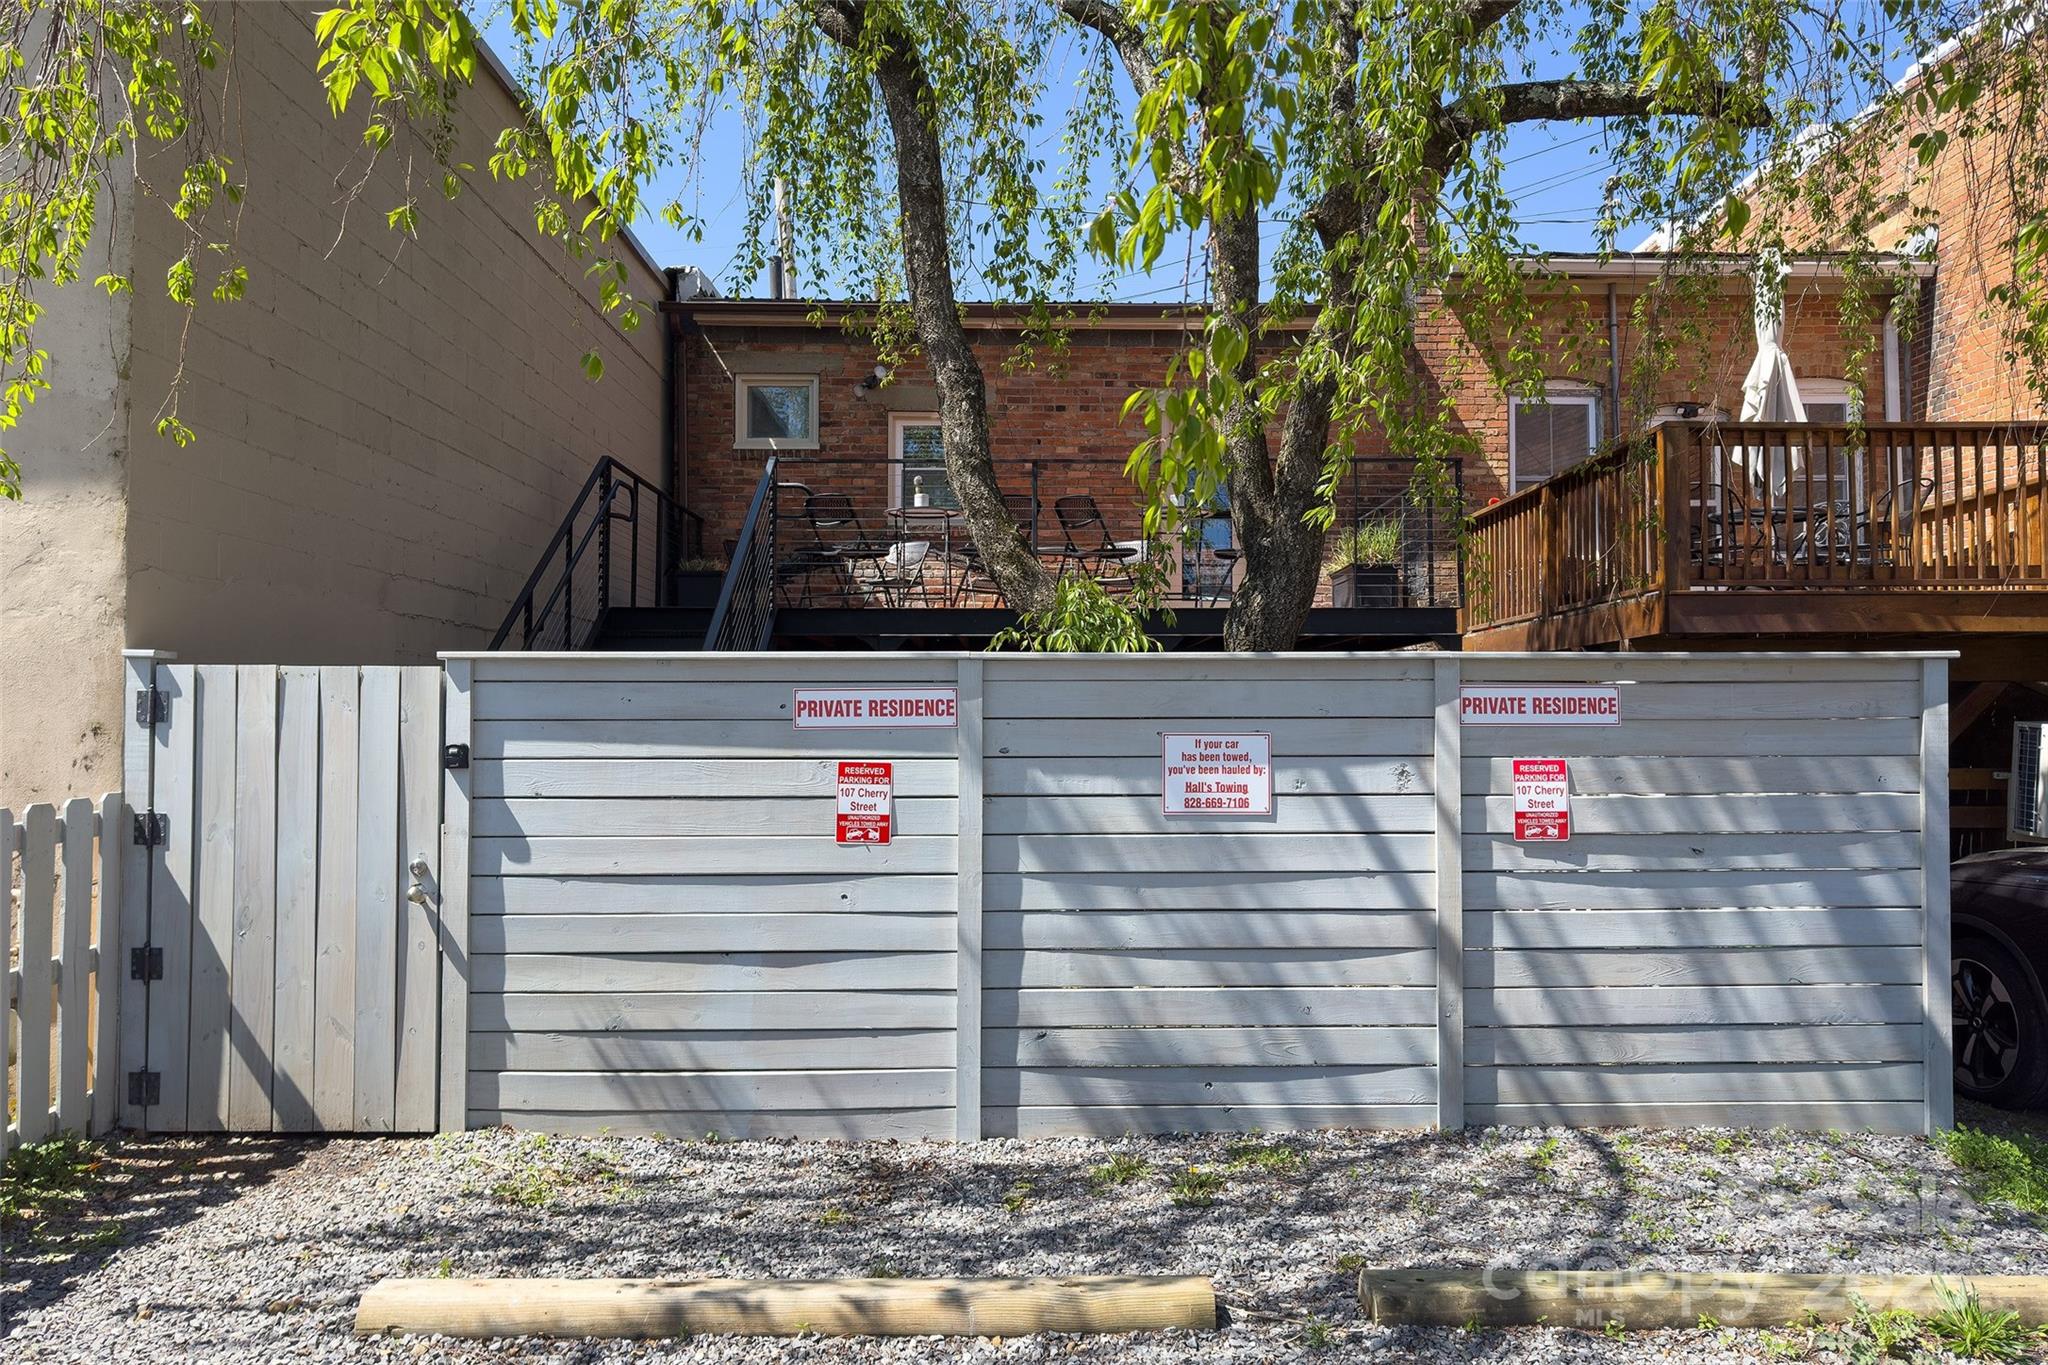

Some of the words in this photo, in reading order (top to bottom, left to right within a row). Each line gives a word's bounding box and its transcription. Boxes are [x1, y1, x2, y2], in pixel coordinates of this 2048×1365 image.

[797, 700, 862, 717] PRIVATE
[868, 699, 955, 717] RESIDENCE
[1462, 697, 1526, 714] PRIVATE
[1532, 697, 1617, 714] RESIDENCE
[1195, 739, 1201, 749] If
[1203, 741, 1223, 751] your
[1225, 741, 1239, 749] car
[1181, 752, 1197, 761] has
[1199, 752, 1220, 761] been
[1222, 752, 1252, 763] towed,
[844, 766, 885, 775] RESERVED
[1168, 765, 1196, 776] you've
[1198, 765, 1219, 775] been
[1221, 765, 1251, 775] hauled
[1253, 765, 1266, 776] by:
[1519, 764, 1560, 772] RESERVED
[839, 776, 873, 784] PARKING
[1185, 782, 1213, 793] Hall's
[1215, 782, 1249, 794] Towing
[1517, 785, 1532, 795] 107
[1534, 785, 1565, 797] Cherry
[840, 788, 855, 798] 107
[857, 788, 889, 800] Cherry
[850, 801, 877, 811] Street
[1184, 798, 1250, 809] 828-669-7106
[1527, 799, 1554, 809] Street
